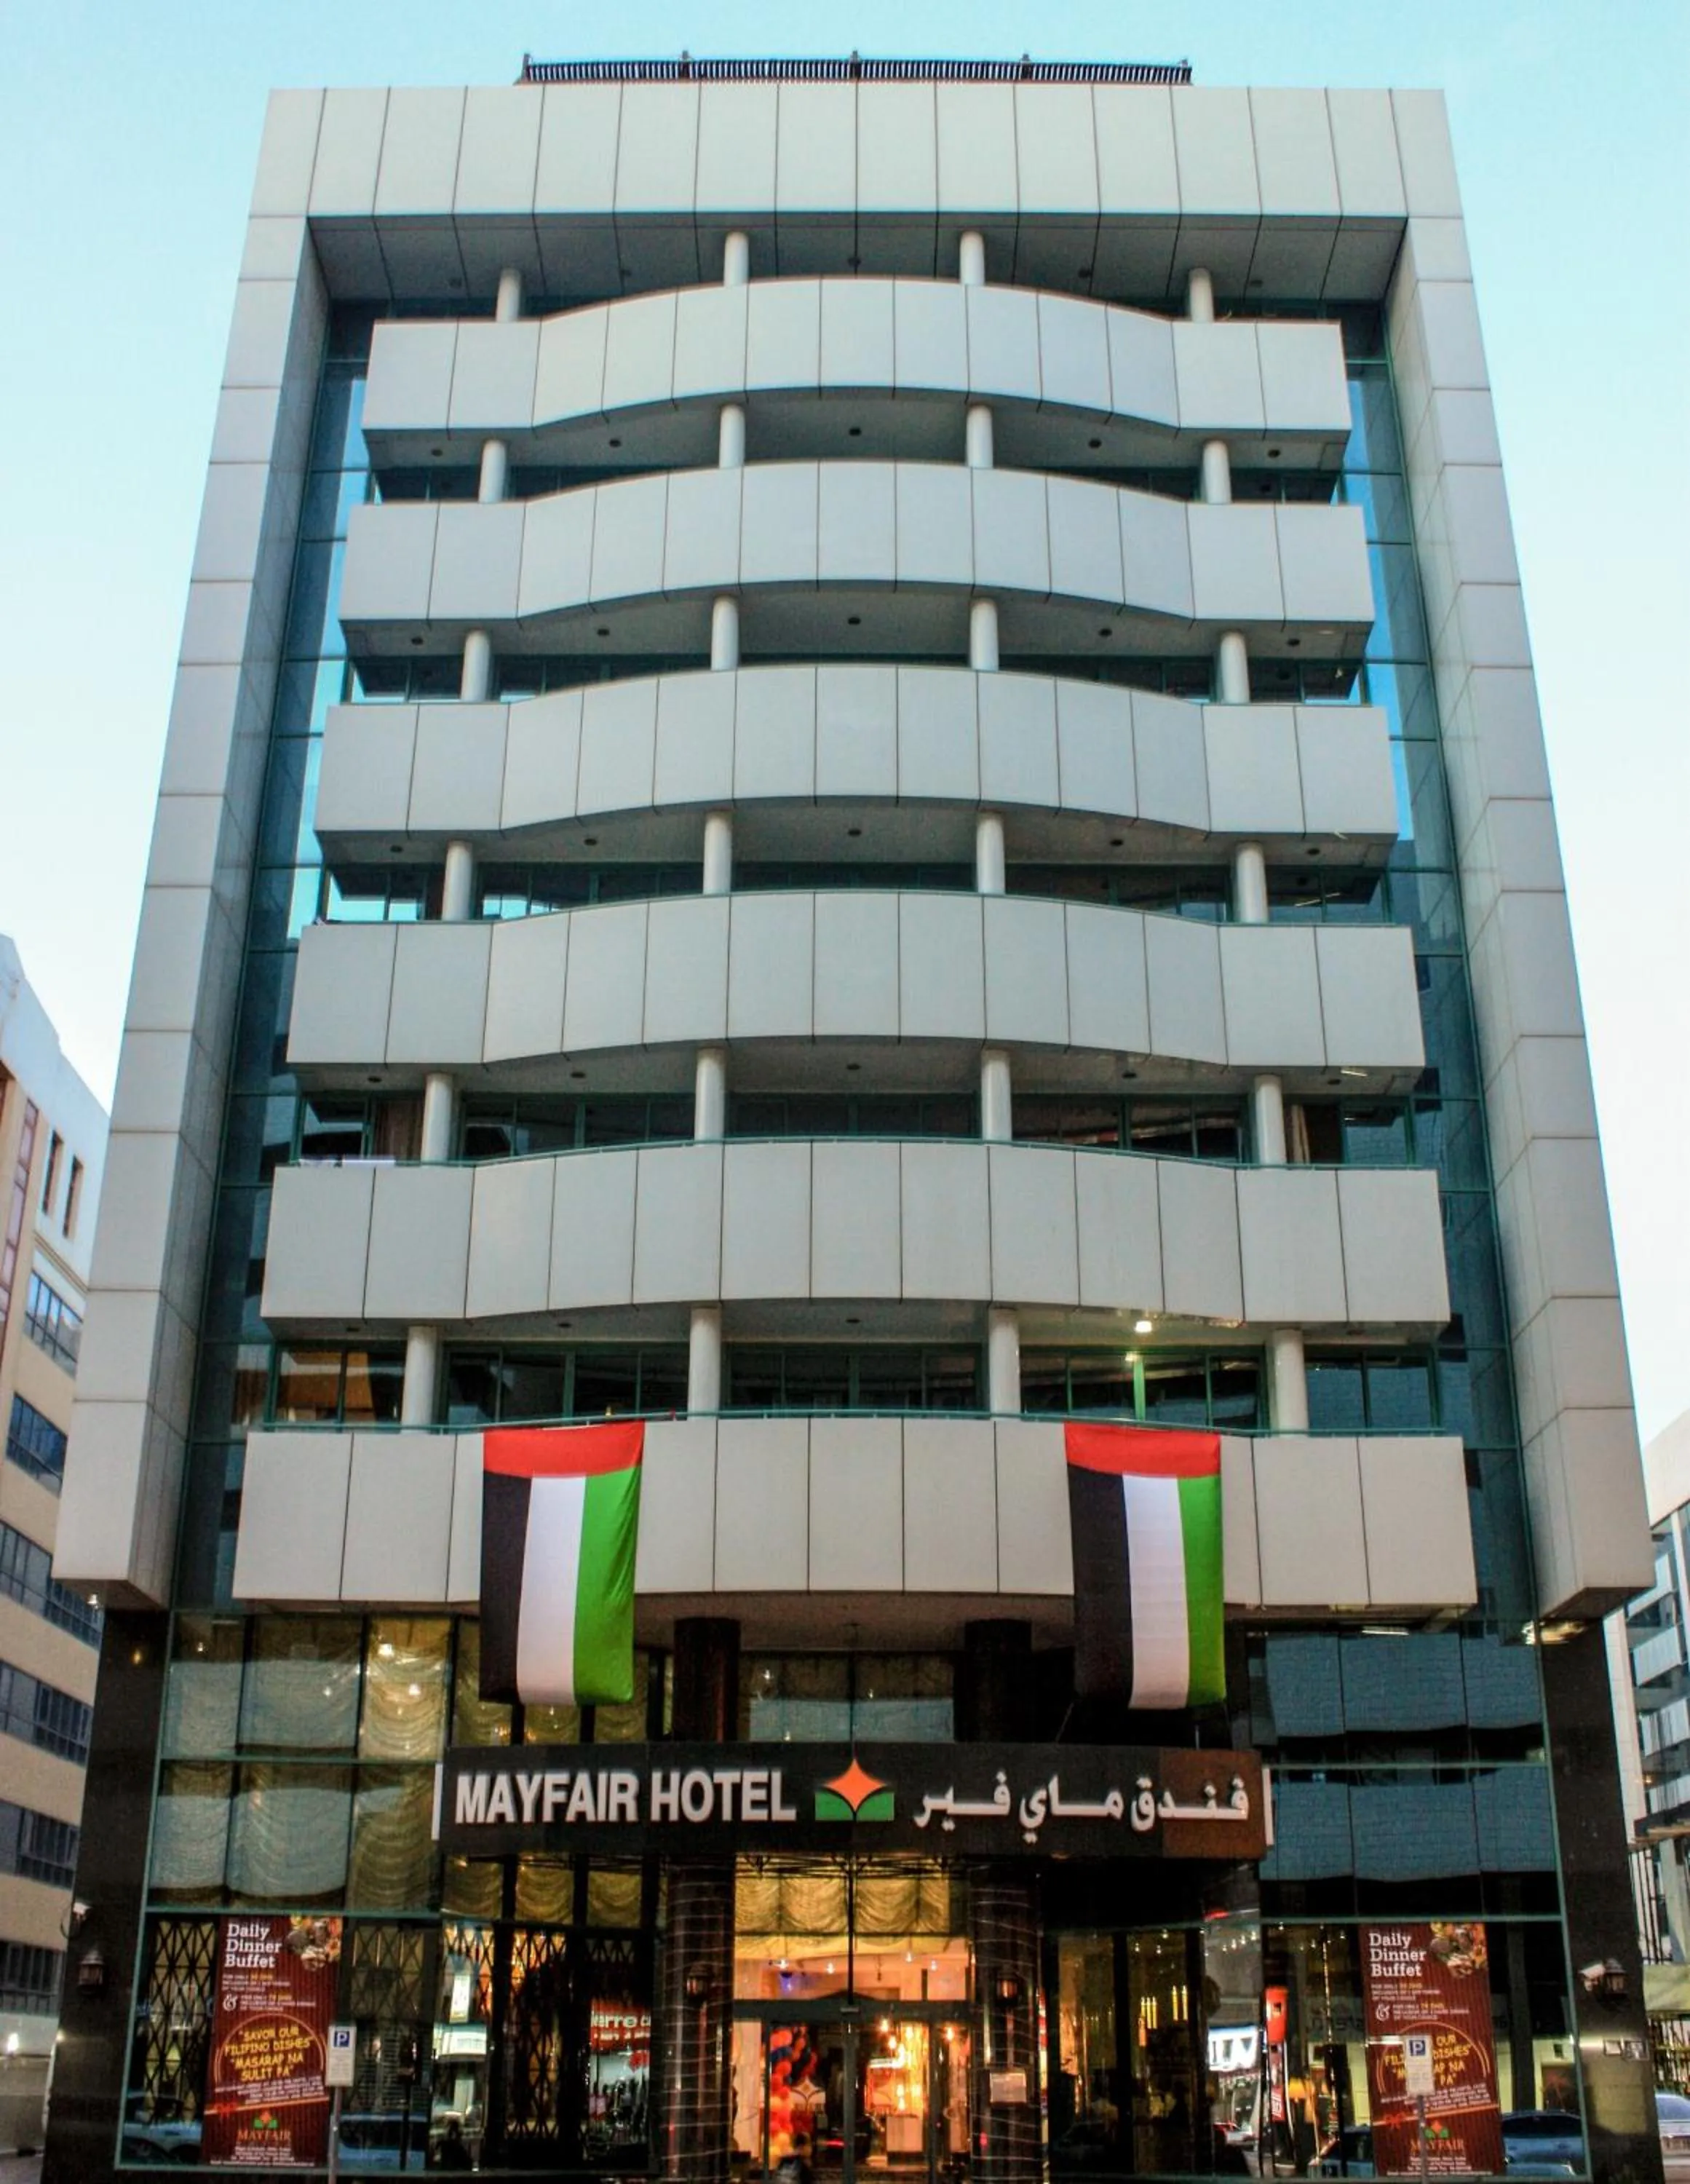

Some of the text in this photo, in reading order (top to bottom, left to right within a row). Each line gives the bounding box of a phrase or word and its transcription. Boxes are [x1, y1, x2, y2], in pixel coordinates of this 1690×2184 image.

[455, 1768, 797, 1824] MAYFAIR HOTEL
[913, 1768, 1249, 1843] فندق ماي فير
[227, 1923, 270, 1941] Daily
[226, 1939, 282, 1952] Dinner
[1369, 1933, 1412, 1949] Daily
[224, 1953, 276, 1968] Buffet
[1370, 1948, 1427, 1962] Dinner
[1371, 1963, 1422, 1977] Buffet
[337, 2032, 347, 2047] P
[224, 2041, 270, 2057] FILIPINO
[1413, 2041, 1423, 2056] P
[237, 2129, 291, 2142] MAYFAIR
